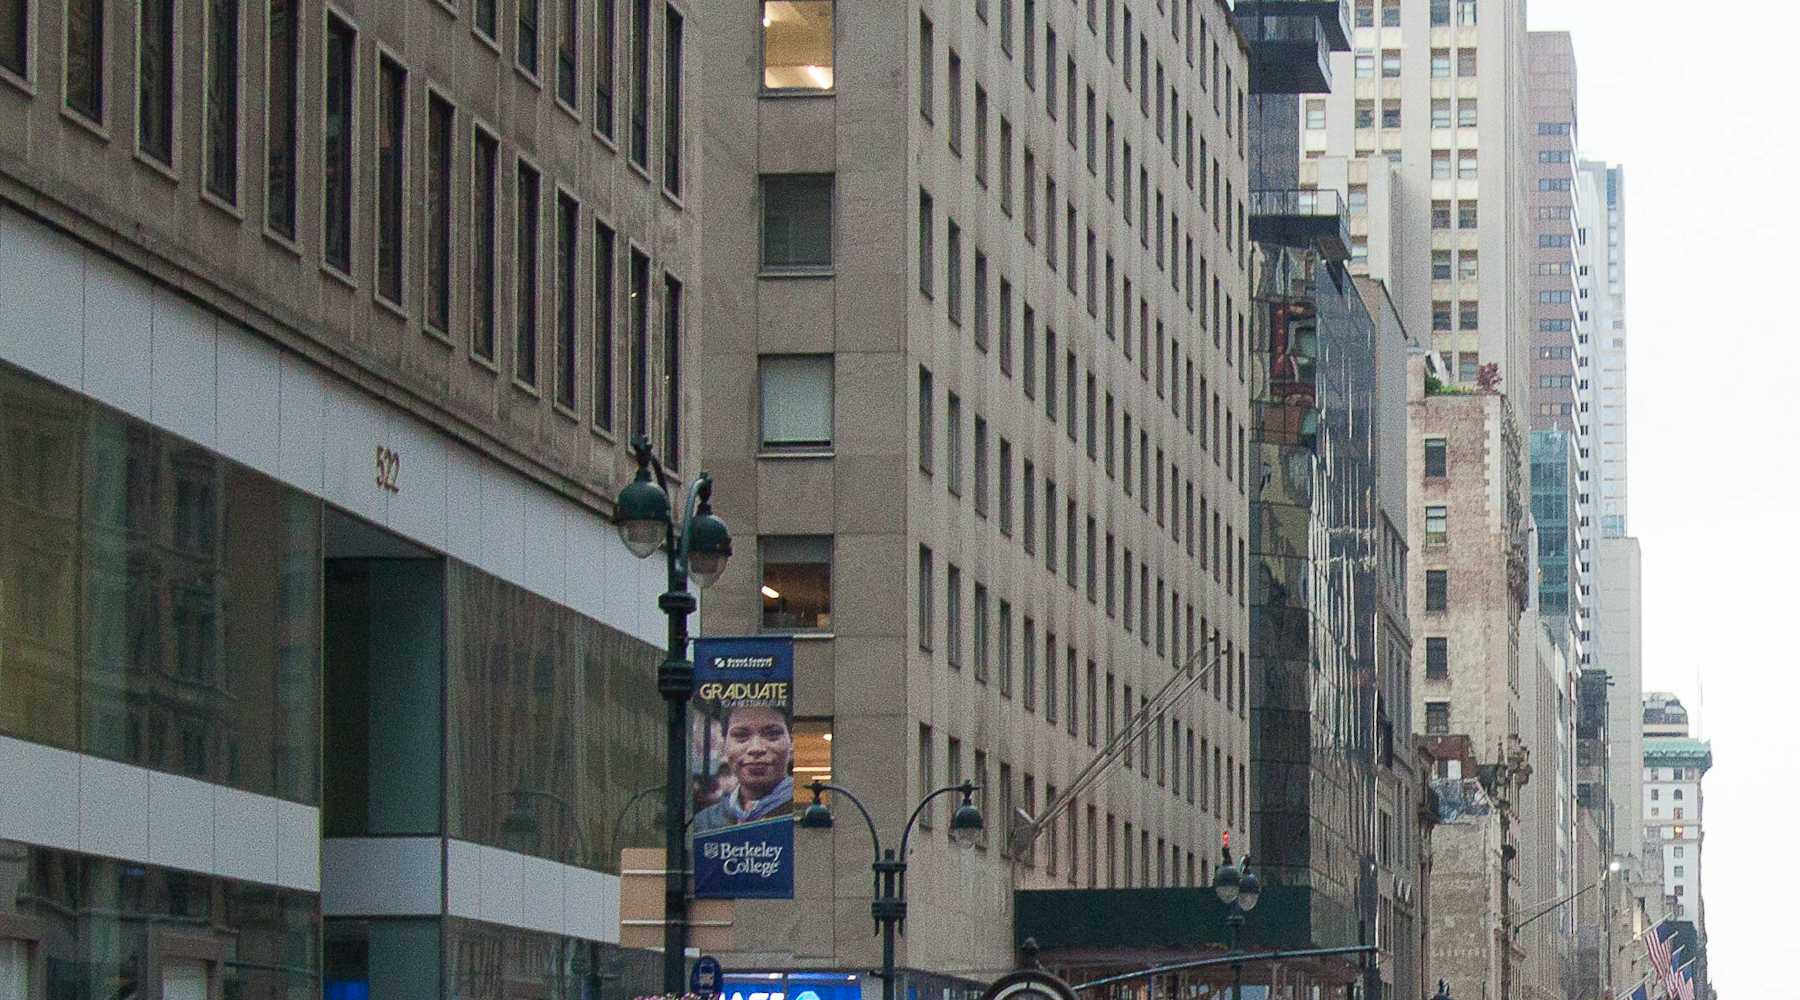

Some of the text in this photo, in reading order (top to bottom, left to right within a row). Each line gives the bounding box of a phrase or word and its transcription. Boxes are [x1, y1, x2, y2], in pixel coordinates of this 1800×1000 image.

[376, 445, 400, 493] 522
[699, 682, 788, 701] GRADUATE
[720, 841, 783, 862] Berkeley
[723, 857, 779, 878] College
